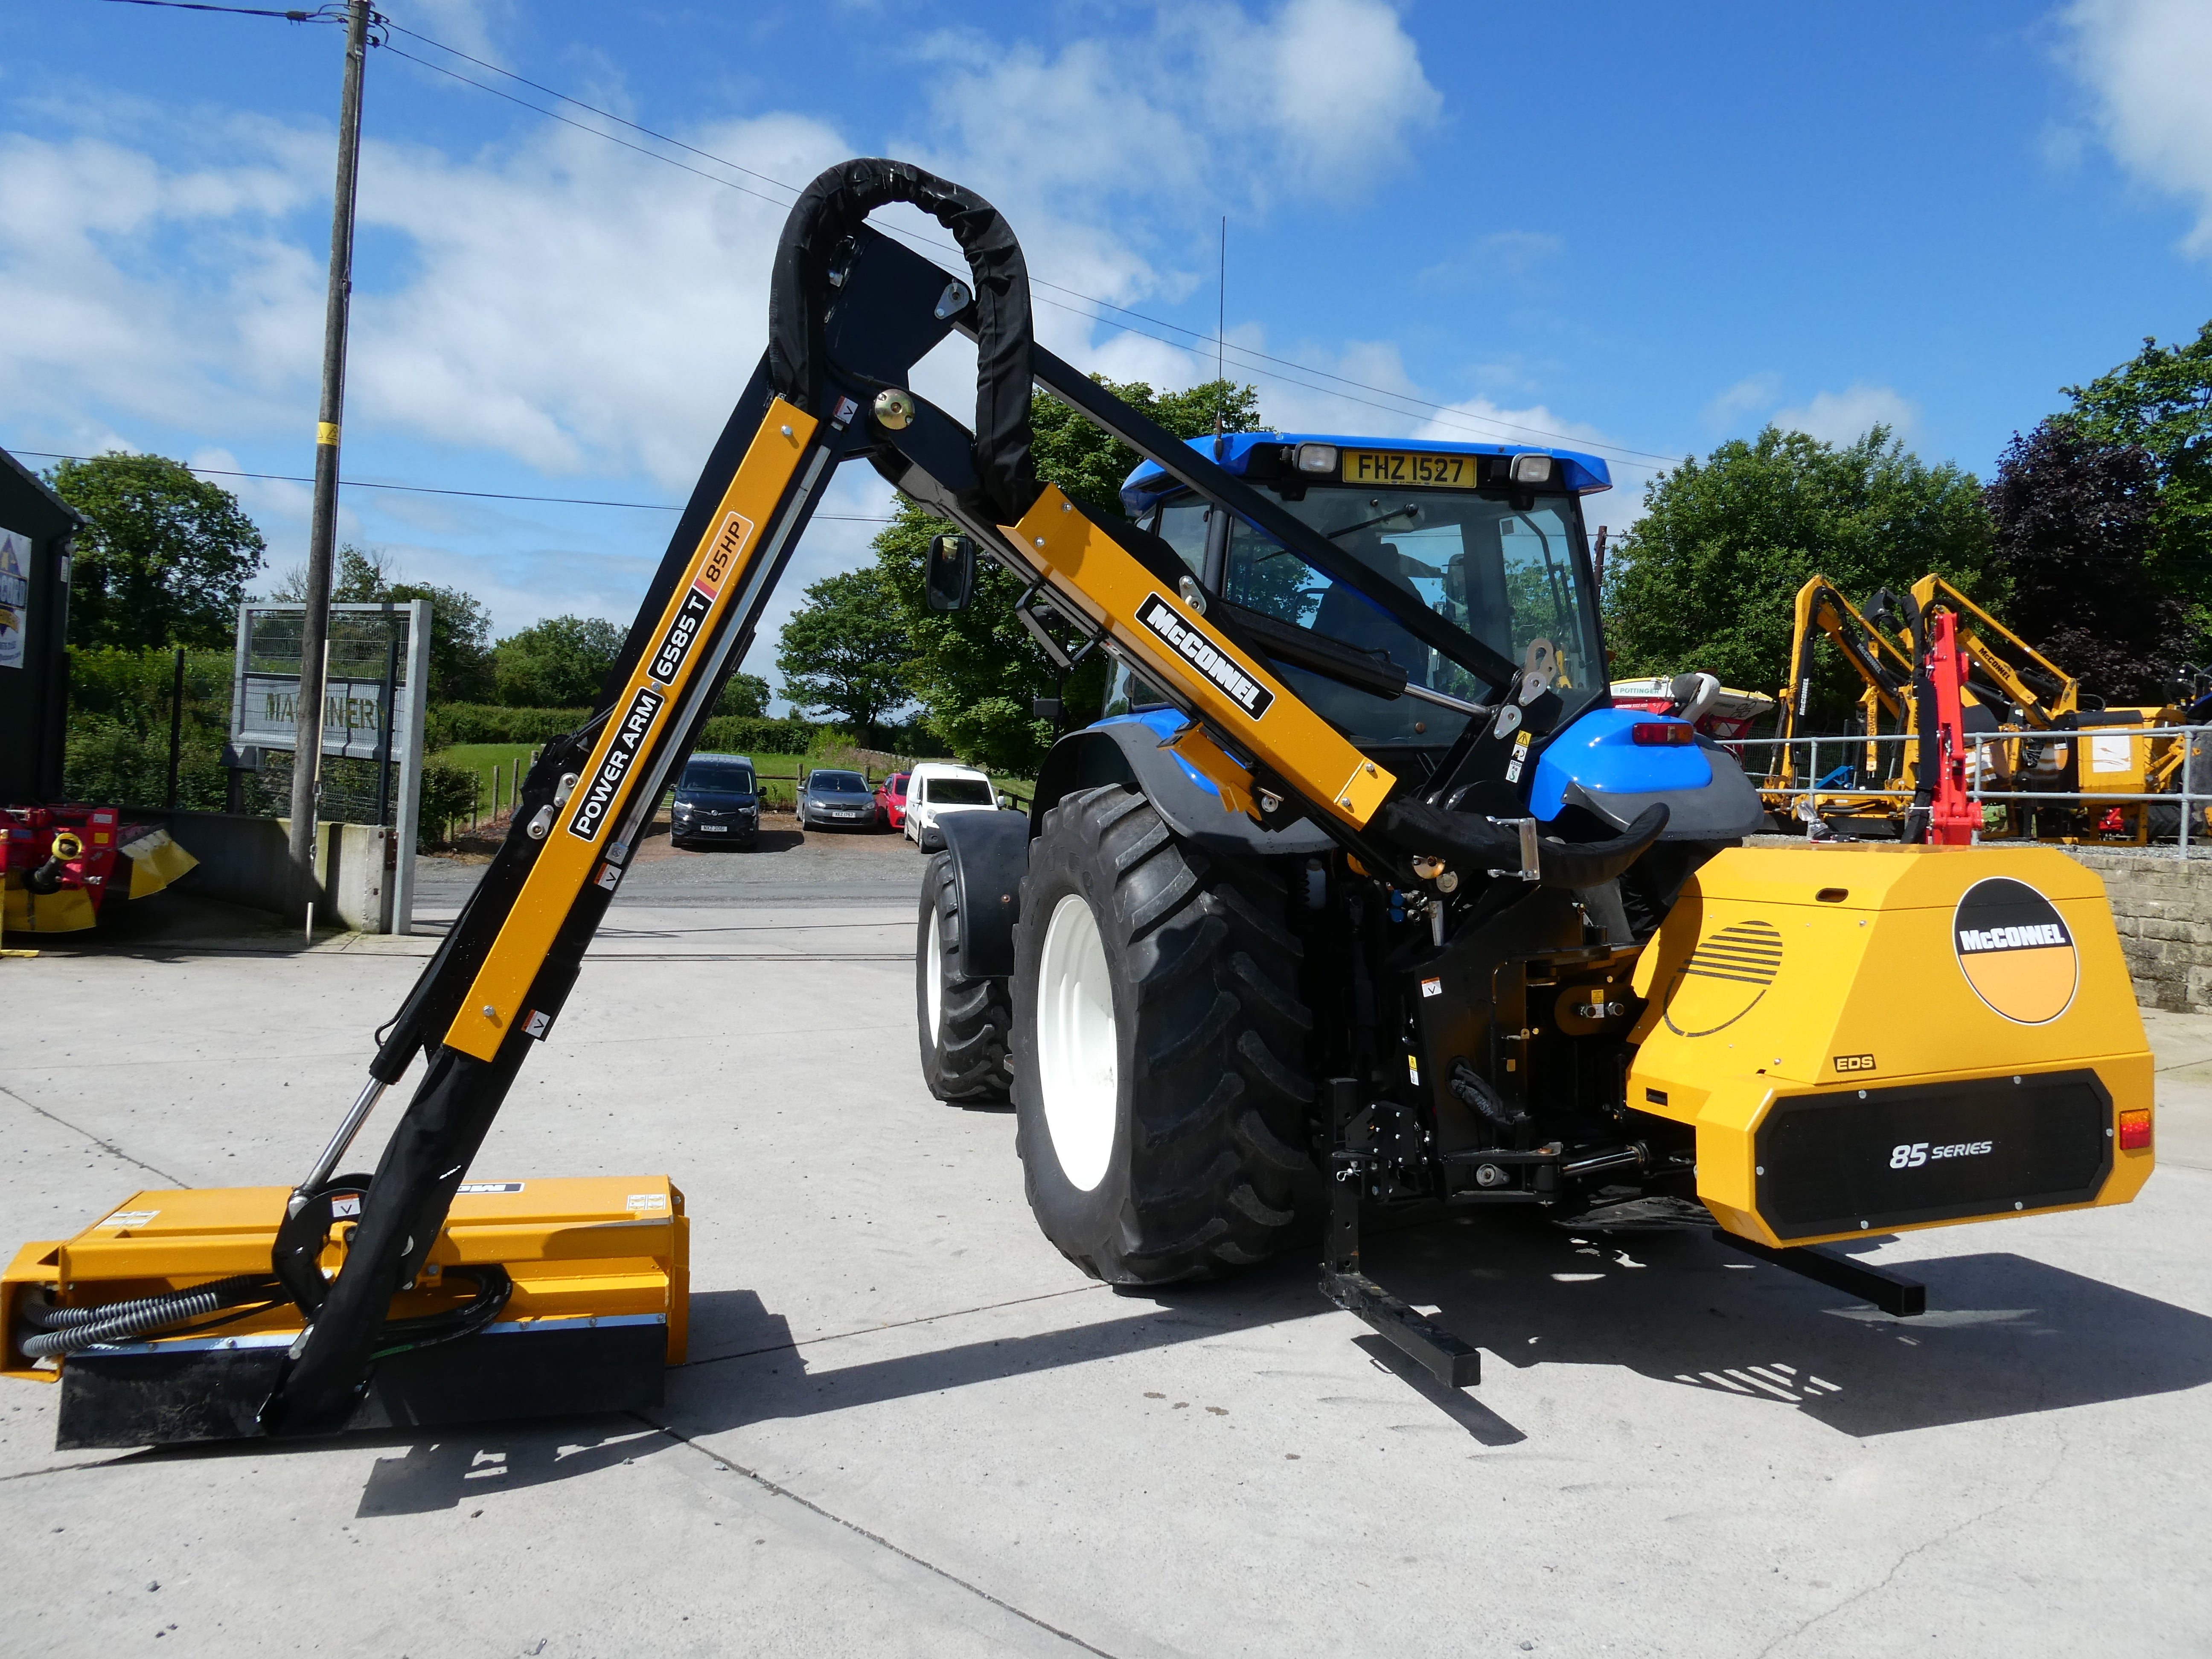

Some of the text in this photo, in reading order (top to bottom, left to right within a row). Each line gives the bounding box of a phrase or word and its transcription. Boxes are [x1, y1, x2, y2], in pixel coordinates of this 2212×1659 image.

[1359, 454, 1463, 483] FHZ 1527
[706, 521, 739, 582] 85HP
[657, 595, 704, 676] 6585 T
[576, 695, 657, 834] POWER ARM
[1837, 1056, 1873, 1070] EDS
[1889, 1141, 1993, 1169] 85 SERIES
